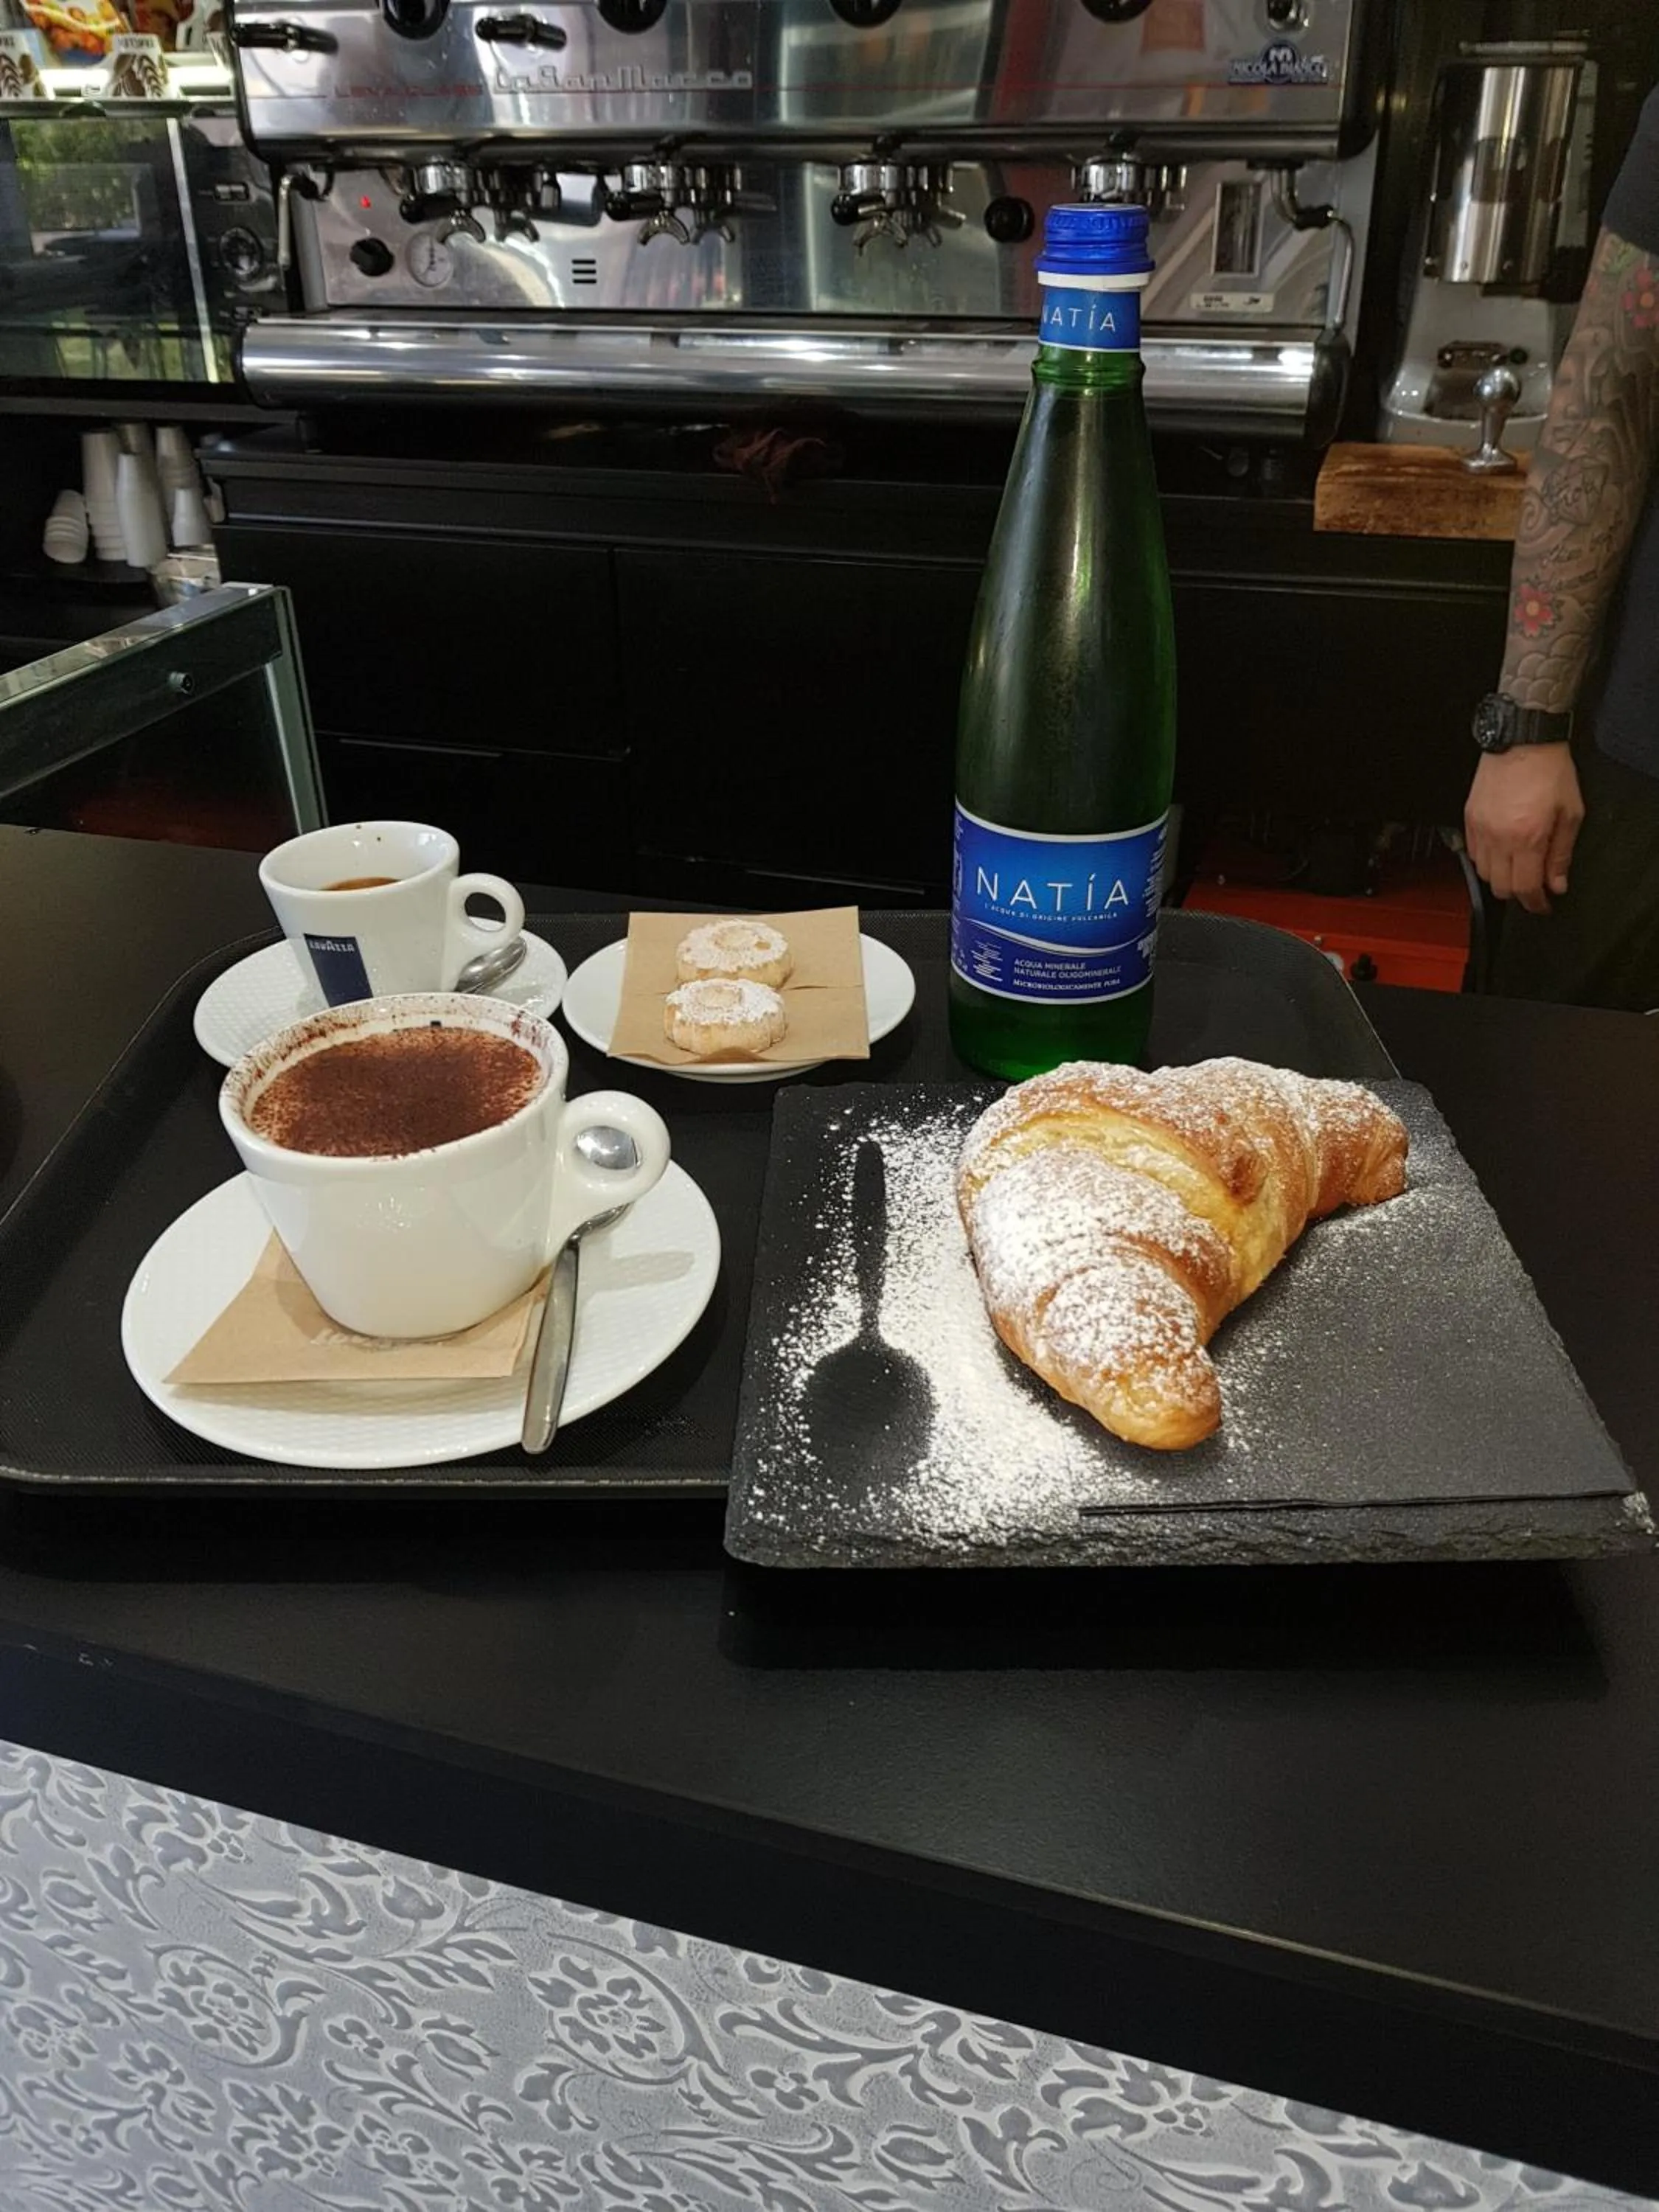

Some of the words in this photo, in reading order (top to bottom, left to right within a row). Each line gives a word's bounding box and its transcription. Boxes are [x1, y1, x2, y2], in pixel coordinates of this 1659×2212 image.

[976, 866, 1130, 912] NATÍA
[309, 939, 355, 952] LAVAZZA
[1014, 959, 1043, 969] ACQUA
[1045, 962, 1086, 970] MINERALE
[1014, 967, 1057, 978] NATURALE
[1058, 965, 1121, 978] OLIGOMINERALE
